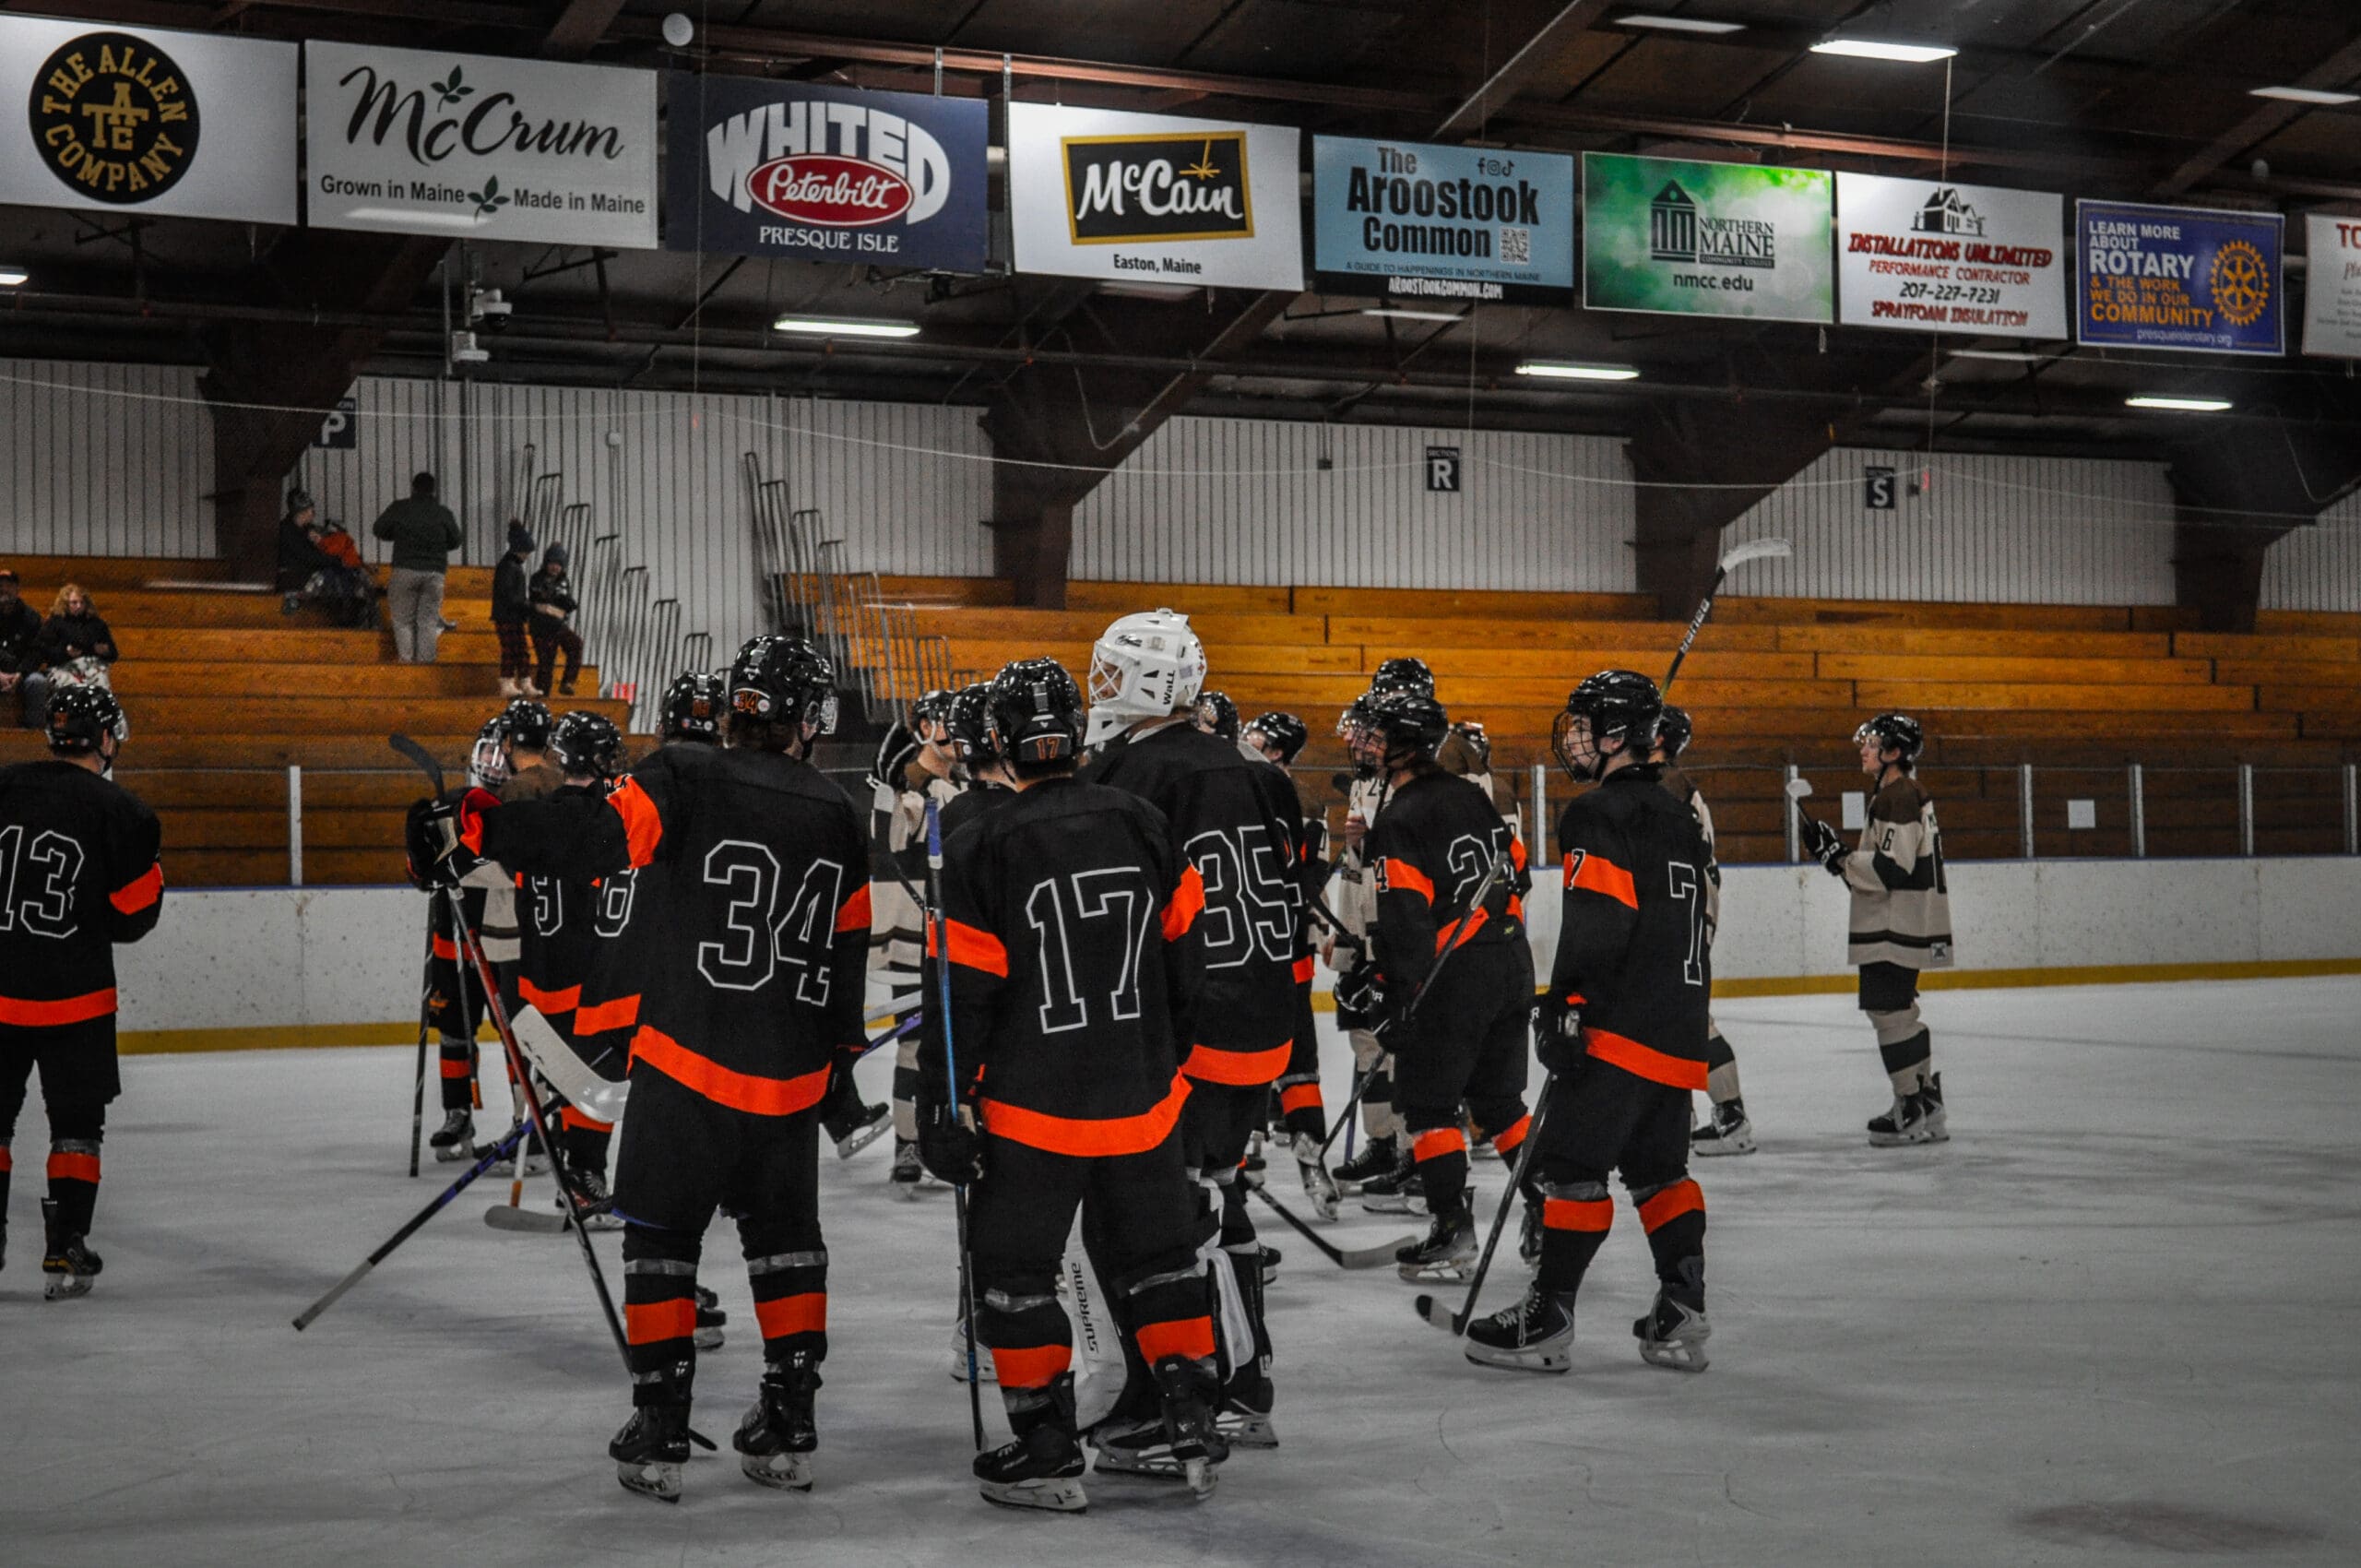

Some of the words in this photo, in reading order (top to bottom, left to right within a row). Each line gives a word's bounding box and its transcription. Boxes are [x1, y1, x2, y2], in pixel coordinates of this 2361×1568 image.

[42, 52, 94, 113] THE
[99, 44, 187, 123] ALLEN
[339, 65, 624, 167] McCrum
[46, 123, 184, 192] COMPANY
[706, 101, 951, 225] WHITED
[1377, 147, 1418, 175] The
[321, 174, 381, 197] Grown
[388, 180, 404, 200] in
[410, 182, 465, 204] Maine
[514, 188, 563, 209] Made
[569, 192, 586, 211] in
[591, 194, 646, 214] Maine
[767, 164, 900, 208] Peterbilt
[1075, 159, 1244, 220] McCain
[1347, 166, 1539, 225] Aroostook
[759, 226, 851, 250] PRESQUE
[858, 233, 898, 253] ISLE
[1363, 216, 1490, 257] Common
[1699, 218, 1774, 234] NORTHERN
[2089, 220, 2137, 237] LEARN
[2141, 225, 2181, 240] MORE
[1700, 232, 1774, 257] MAINE
[1847, 232, 1961, 261] INSTALLATIONS
[1964, 243, 2053, 267] UNLIMITED
[2089, 236, 2140, 250] ABOUT
[1113, 254, 1159, 274] Easton,
[1163, 257, 1202, 274] Maine
[1869, 259, 1951, 279] PERFORMANCE
[1956, 267, 2031, 285] CONTRACTOR
[2090, 249, 2195, 279] ROTARY
[1673, 273, 1753, 291] nmcc.edu
[2107, 277, 2133, 290] THE
[2140, 278, 2180, 291] WORK
[2090, 289, 2111, 302] WE
[2118, 290, 2137, 303] DO
[2142, 292, 2156, 304] IN
[2161, 292, 2190, 306] OUR
[1871, 301, 1948, 323] SPRAYFOAM
[1950, 306, 2028, 327] INSULATION
[2091, 303, 2213, 327] COMMUNITY
[322, 412, 346, 445] P
[1432, 459, 1453, 489] R
[1872, 478, 1889, 506] S
[1036, 738, 1060, 760] 17
[1182, 823, 1294, 968] 35
[697, 838, 843, 1007] 34
[1668, 861, 1703, 986] 7
[1025, 866, 1154, 1034] 17
